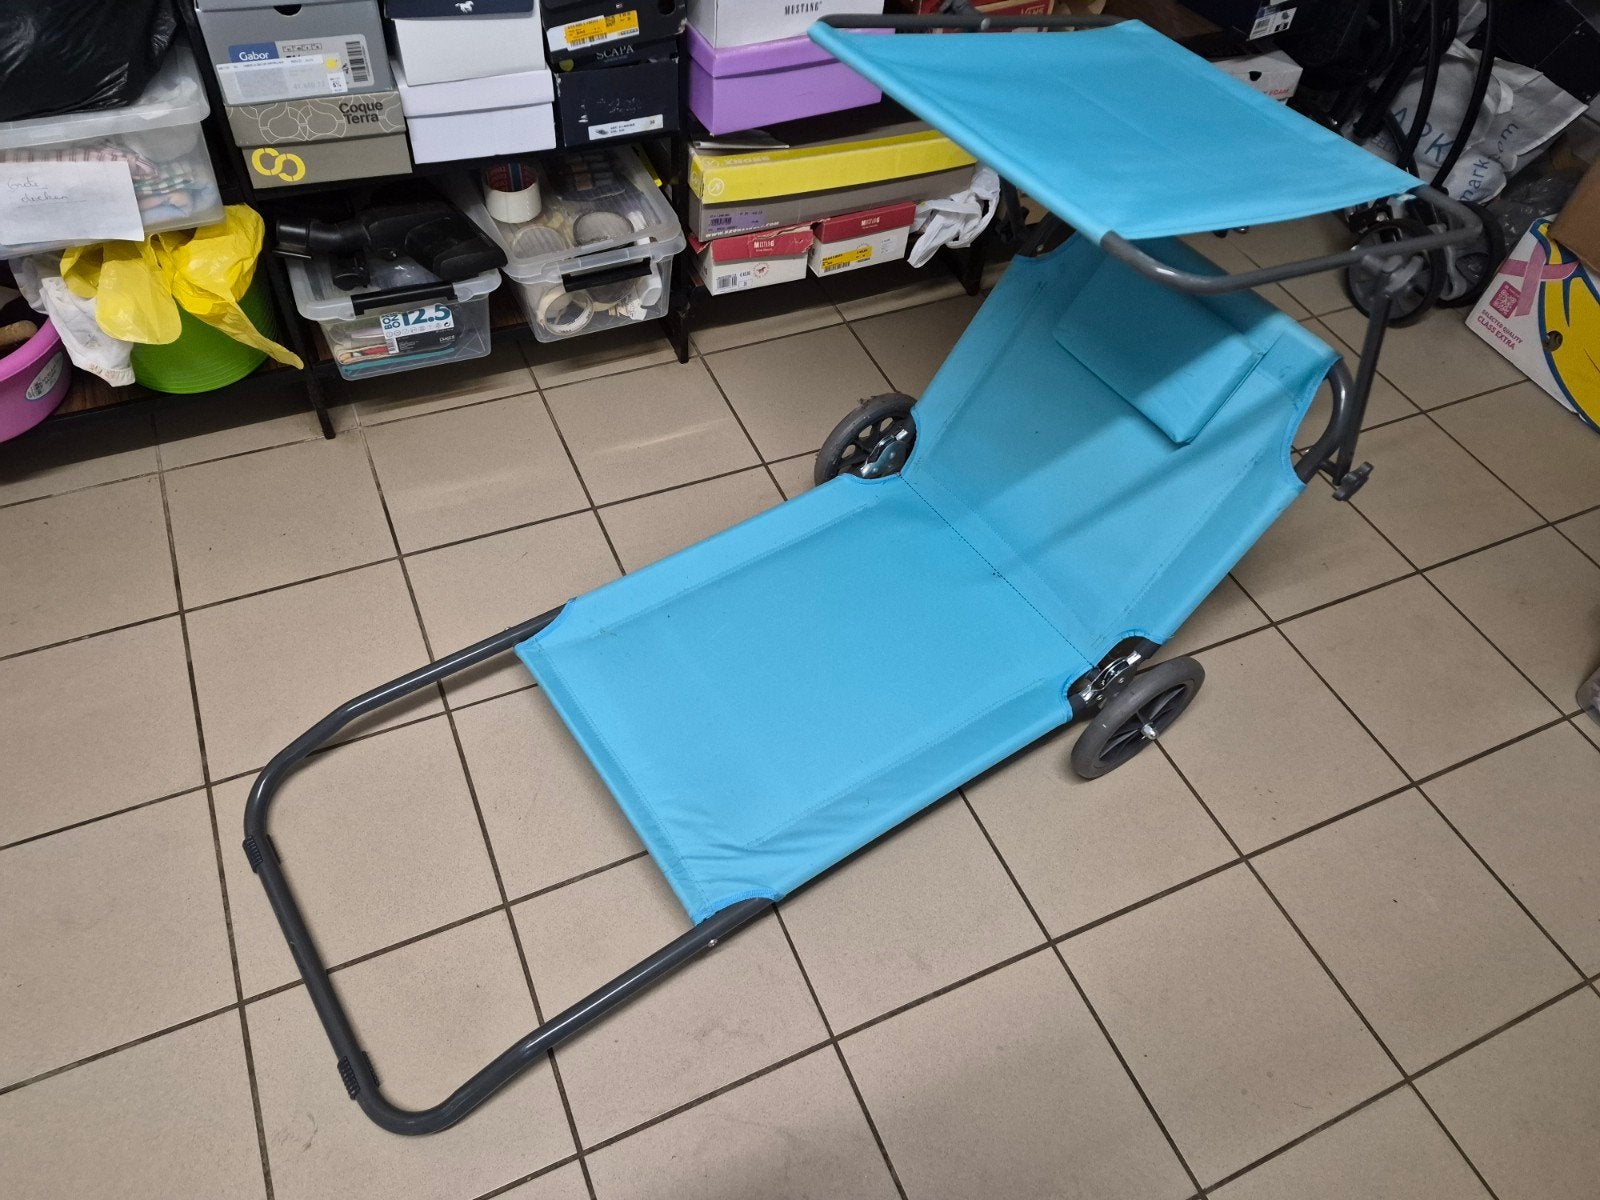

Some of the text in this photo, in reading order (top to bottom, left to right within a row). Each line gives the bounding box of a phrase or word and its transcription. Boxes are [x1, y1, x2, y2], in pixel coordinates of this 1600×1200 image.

[238, 51, 269, 61] Gabor
[596, 44, 634, 60] SCAPA
[338, 101, 383, 117] Coque
[342, 113, 379, 125] Terra
[401, 303, 451, 327] 12.5
[1477, 315, 1516, 350] CLASS EXTRA
[1481, 309, 1523, 343] SELECTED QUALITY
